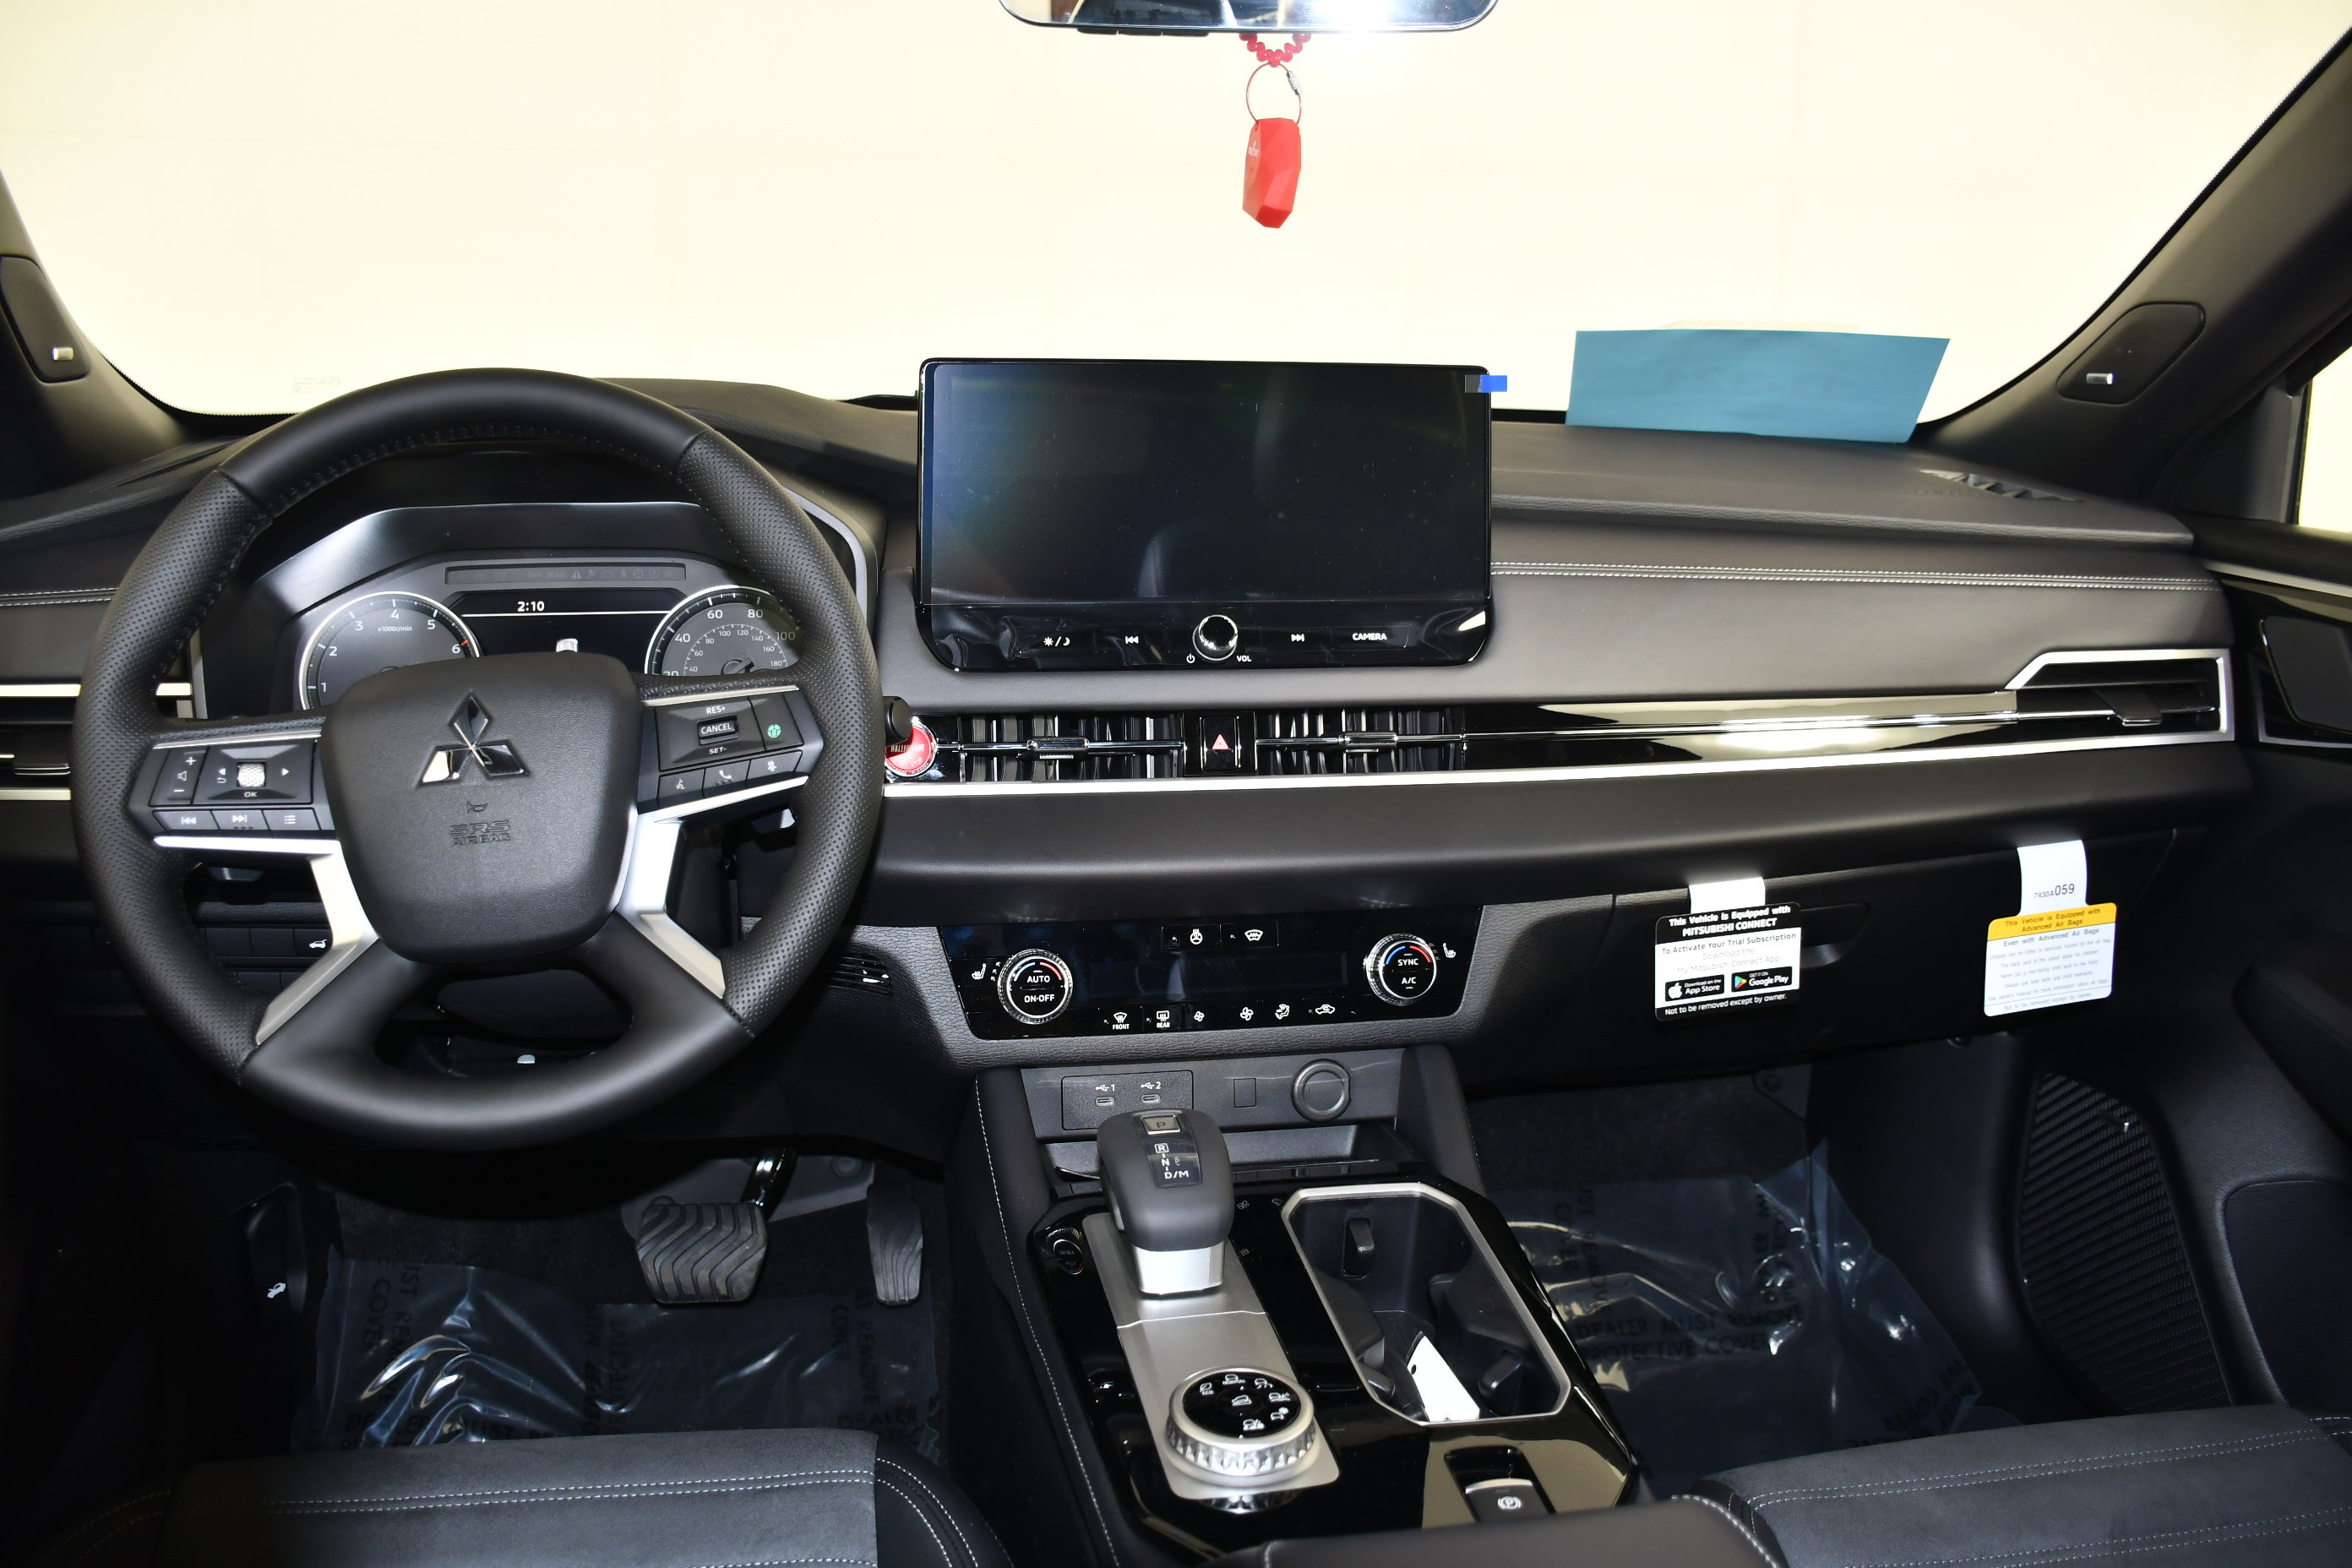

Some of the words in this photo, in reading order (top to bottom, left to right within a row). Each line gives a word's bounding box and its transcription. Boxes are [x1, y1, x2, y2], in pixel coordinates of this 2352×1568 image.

[517, 601, 545, 612] 2:10
[390, 609, 400, 619] 4
[707, 609, 722, 619] 60
[748, 608, 764, 618] 80
[355, 620, 363, 631] 3
[427, 619, 436, 629] 5
[674, 634, 691, 643] 40
[776, 631, 796, 640] 100
[329, 645, 338, 656] 2
[451, 645, 460, 654] 6
[321, 682, 327, 693] 1
[706, 705, 726, 715] RES+
[700, 722, 732, 735] CANCEL
[449, 819, 510, 836] SRS
[451, 832, 511, 847] AIRBAG
[1669, 917, 1686, 927] This
[1689, 914, 1718, 924] Vehicle
[1721, 912, 1729, 921] is
[1731, 907, 1769, 920] Equipped
[1772, 905, 1791, 914] with
[1682, 923, 1734, 937] MITSUBISHI
[1735, 917, 1778, 931] CONNECT
[2022, 923, 2052, 933] Advanced
[2038, 933, 2069, 941] Advanced
[1673, 944, 1706, 953] Activate
[1707, 940, 1725, 949] Your
[1747, 934, 1796, 945] Subscription
[1397, 958, 1419, 966] SYNC
[1402, 977, 1417, 985] A/C
[1749, 977, 1773, 987] Google
[1774, 975, 1789, 984] Play
[1685, 987, 1701, 995] App
[1688, 1004, 1697, 1012] be
[1698, 999, 1729, 1010] removed
[1729, 997, 1753, 1006] except
[1161, 1158, 1170, 1167] N
[1164, 1170, 1190, 1179] D/M
[1576, 1318, 1648, 1337] DEALER
[1662, 1314, 1718, 1333] MUST
